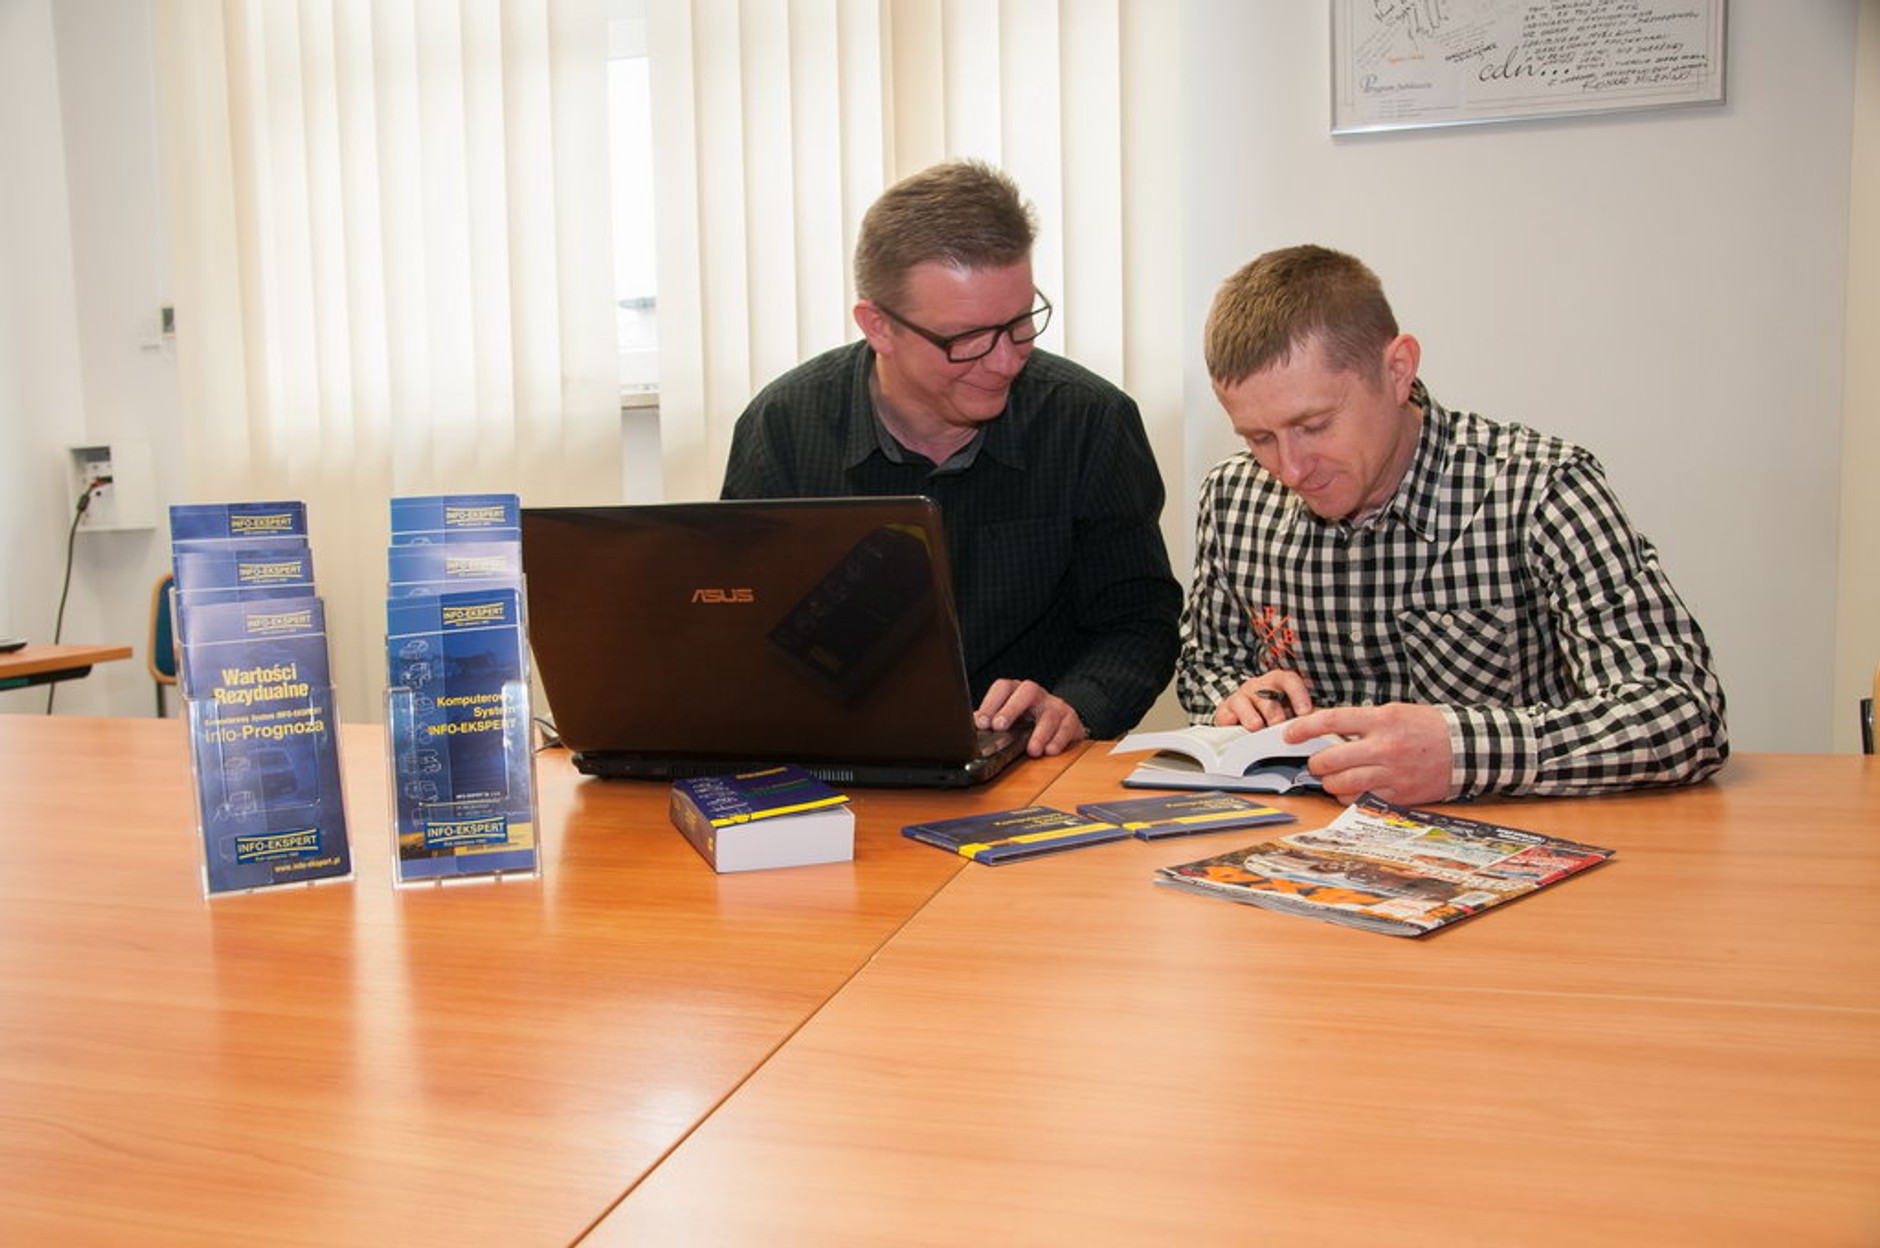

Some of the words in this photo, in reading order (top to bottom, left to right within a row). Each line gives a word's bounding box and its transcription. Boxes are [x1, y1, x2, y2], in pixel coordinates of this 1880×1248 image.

[231, 517, 292, 528] INFO-EKSPERT
[239, 565, 302, 577] INFO-EKSPERT
[691, 588, 754, 603] ASUS
[247, 614, 312, 628] INFO-EKSPERT
[222, 663, 297, 686] Wartości
[213, 682, 310, 706] Rezydualne
[473, 705, 516, 719] System
[204, 719, 325, 743] Info-Prognoza
[428, 717, 517, 736] INFO-EKSPERT
[428, 822, 505, 838] INFO-EKSPERT
[237, 835, 318, 854] INFO-EKSPERT
